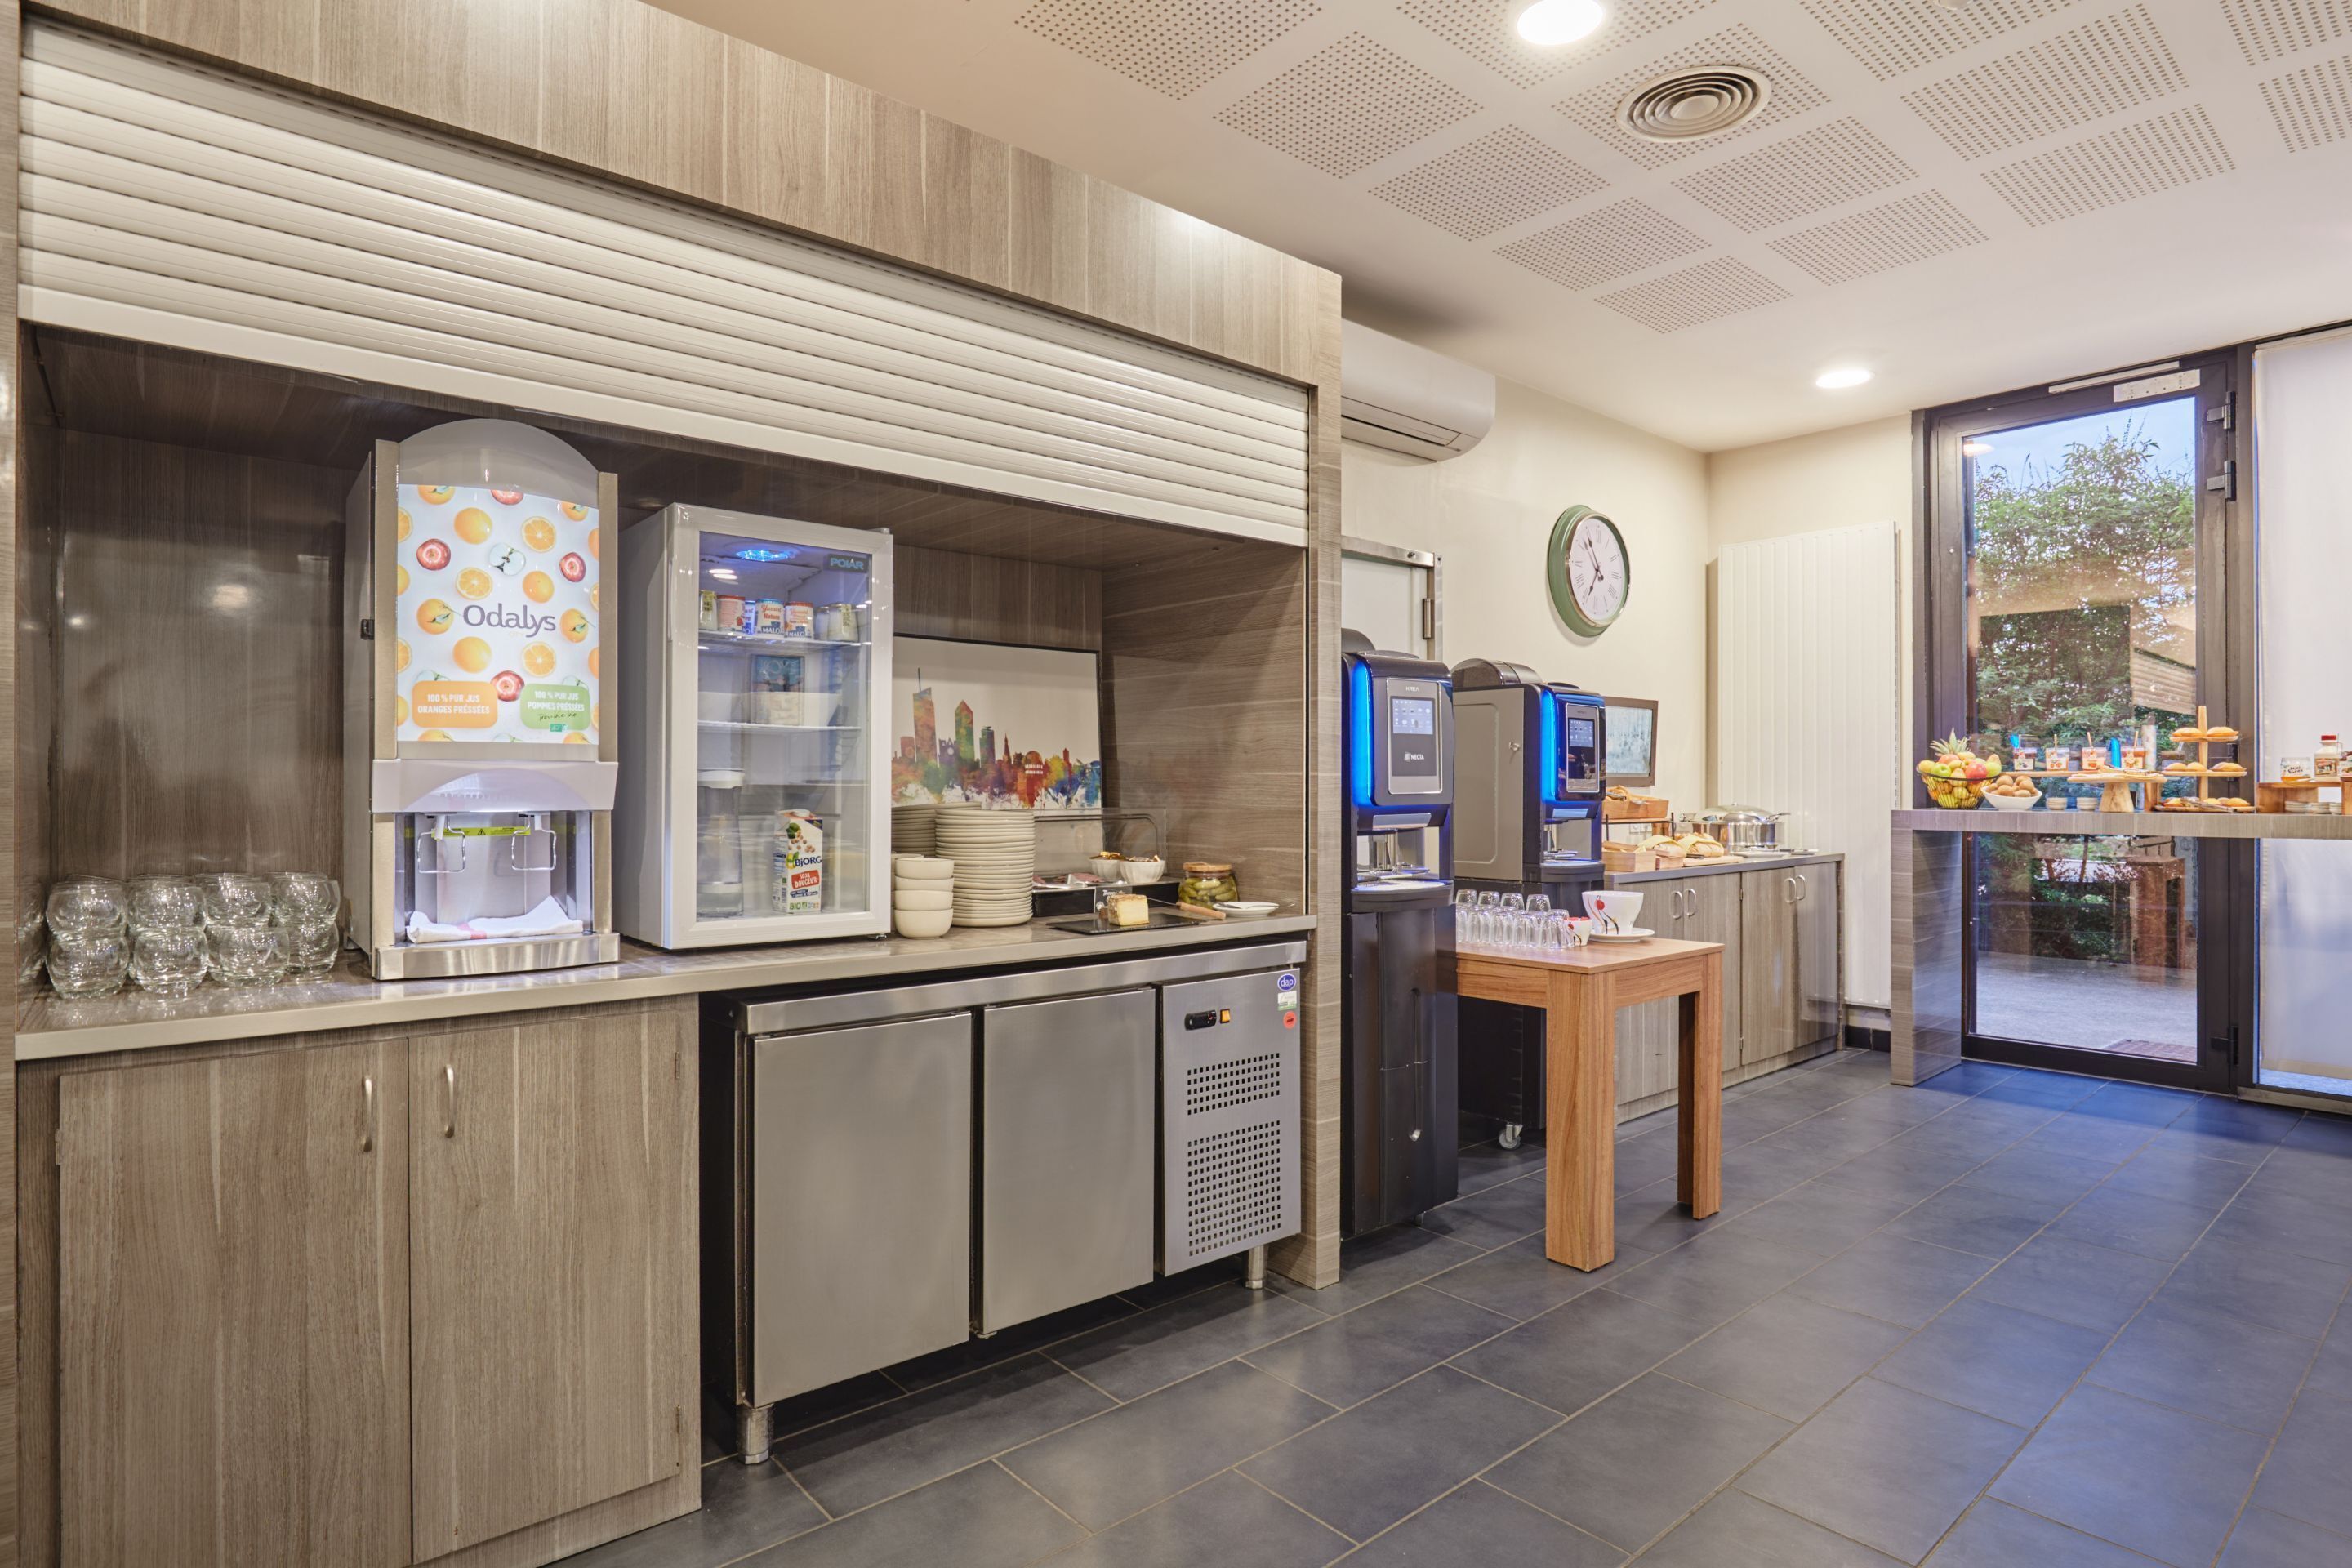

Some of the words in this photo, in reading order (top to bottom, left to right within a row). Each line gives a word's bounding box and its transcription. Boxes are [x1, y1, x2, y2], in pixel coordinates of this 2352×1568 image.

[463, 603, 556, 638] Odalys
[427, 693, 440, 703] 100
[441, 694, 448, 703] %
[448, 694, 464, 703] PUR
[466, 695, 480, 703] JUS
[534, 690, 546, 699] 100
[555, 692, 568, 701] PUR
[568, 693, 579, 701] JUS
[417, 705, 452, 714] ORANGES
[794, 876, 817, 889] DOUCEUR
[790, 902, 801, 911] BIO
[1281, 977, 1294, 988] dap
